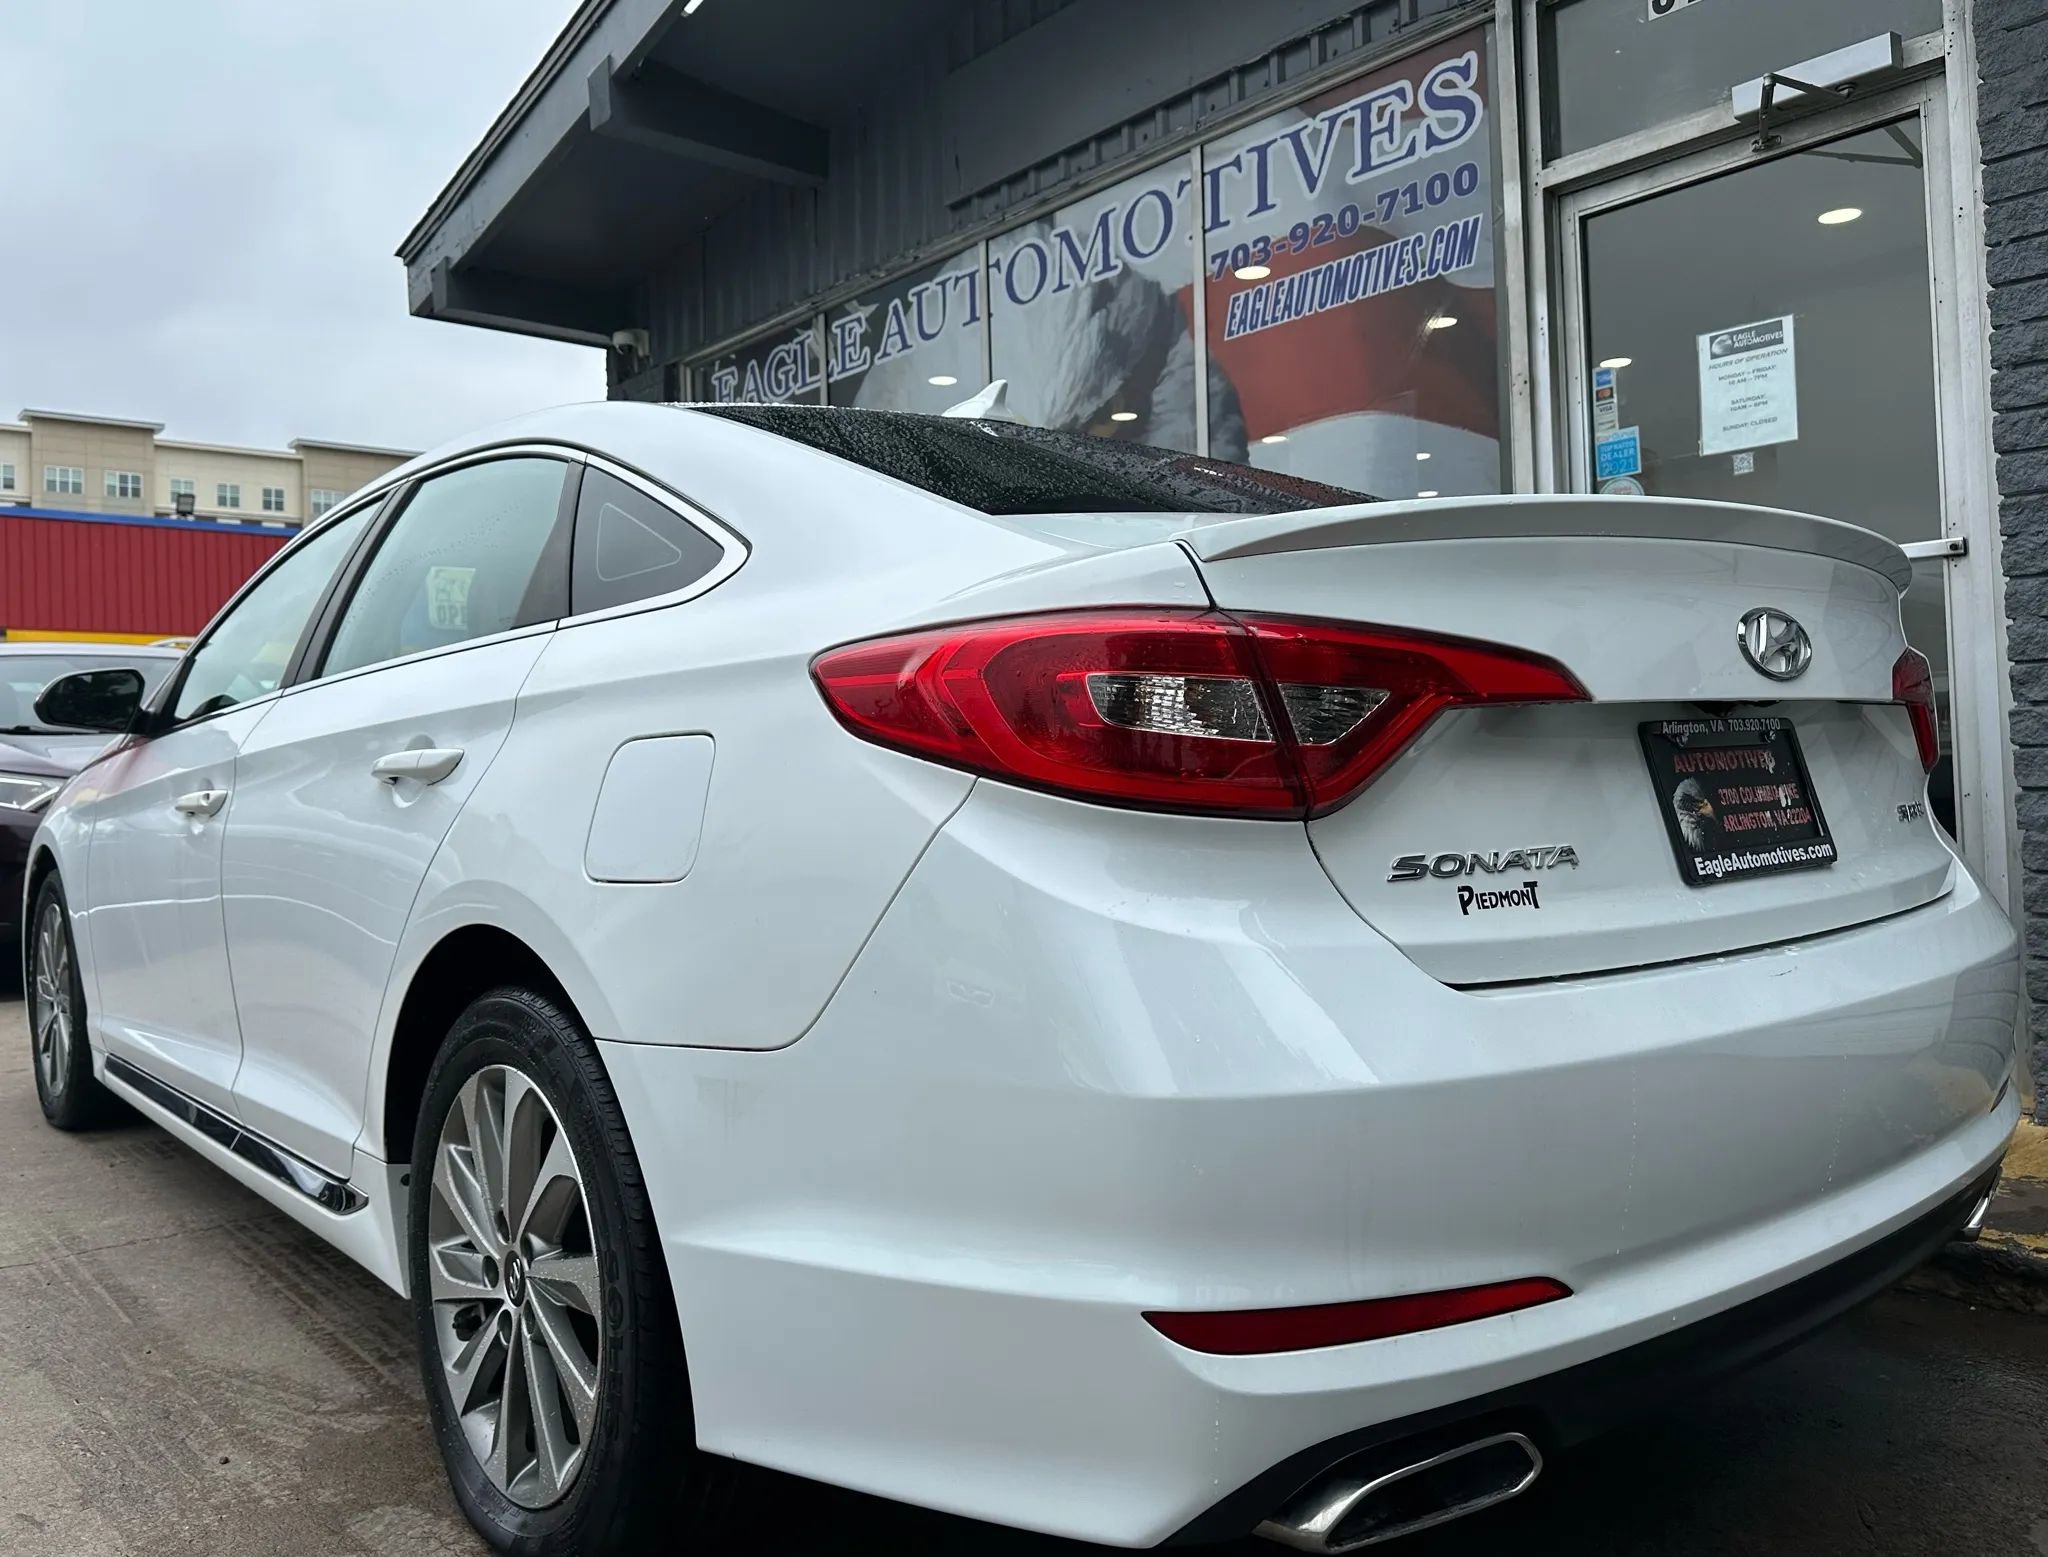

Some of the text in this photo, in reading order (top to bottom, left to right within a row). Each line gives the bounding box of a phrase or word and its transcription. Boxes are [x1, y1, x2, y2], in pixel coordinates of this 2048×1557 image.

[712, 51, 1484, 402] EAGLE AUTOMOTIVES
[1210, 162, 1480, 282] 703-920-7100
[1224, 213, 1483, 341] EAGLEAUTOMOTIVES.COM
[1733, 331, 1756, 341] EAGLE
[1734, 331, 1784, 348] AUTOMOTIVES
[1709, 360, 1733, 370] HOURS
[1745, 348, 1788, 363] OPERATION
[1718, 371, 1745, 380] MONDAY
[1750, 416, 1778, 426] CLOSED
[1600, 448, 1636, 461] DEALER
[1601, 458, 1636, 476] 2021
[1662, 718, 1781, 735] Arlington, VA 703.920.7100
[1387, 844, 1580, 882] SONATA
[1694, 843, 1833, 877] EagleAutomotives.com
[1457, 881, 1540, 915] PIEDMONT
